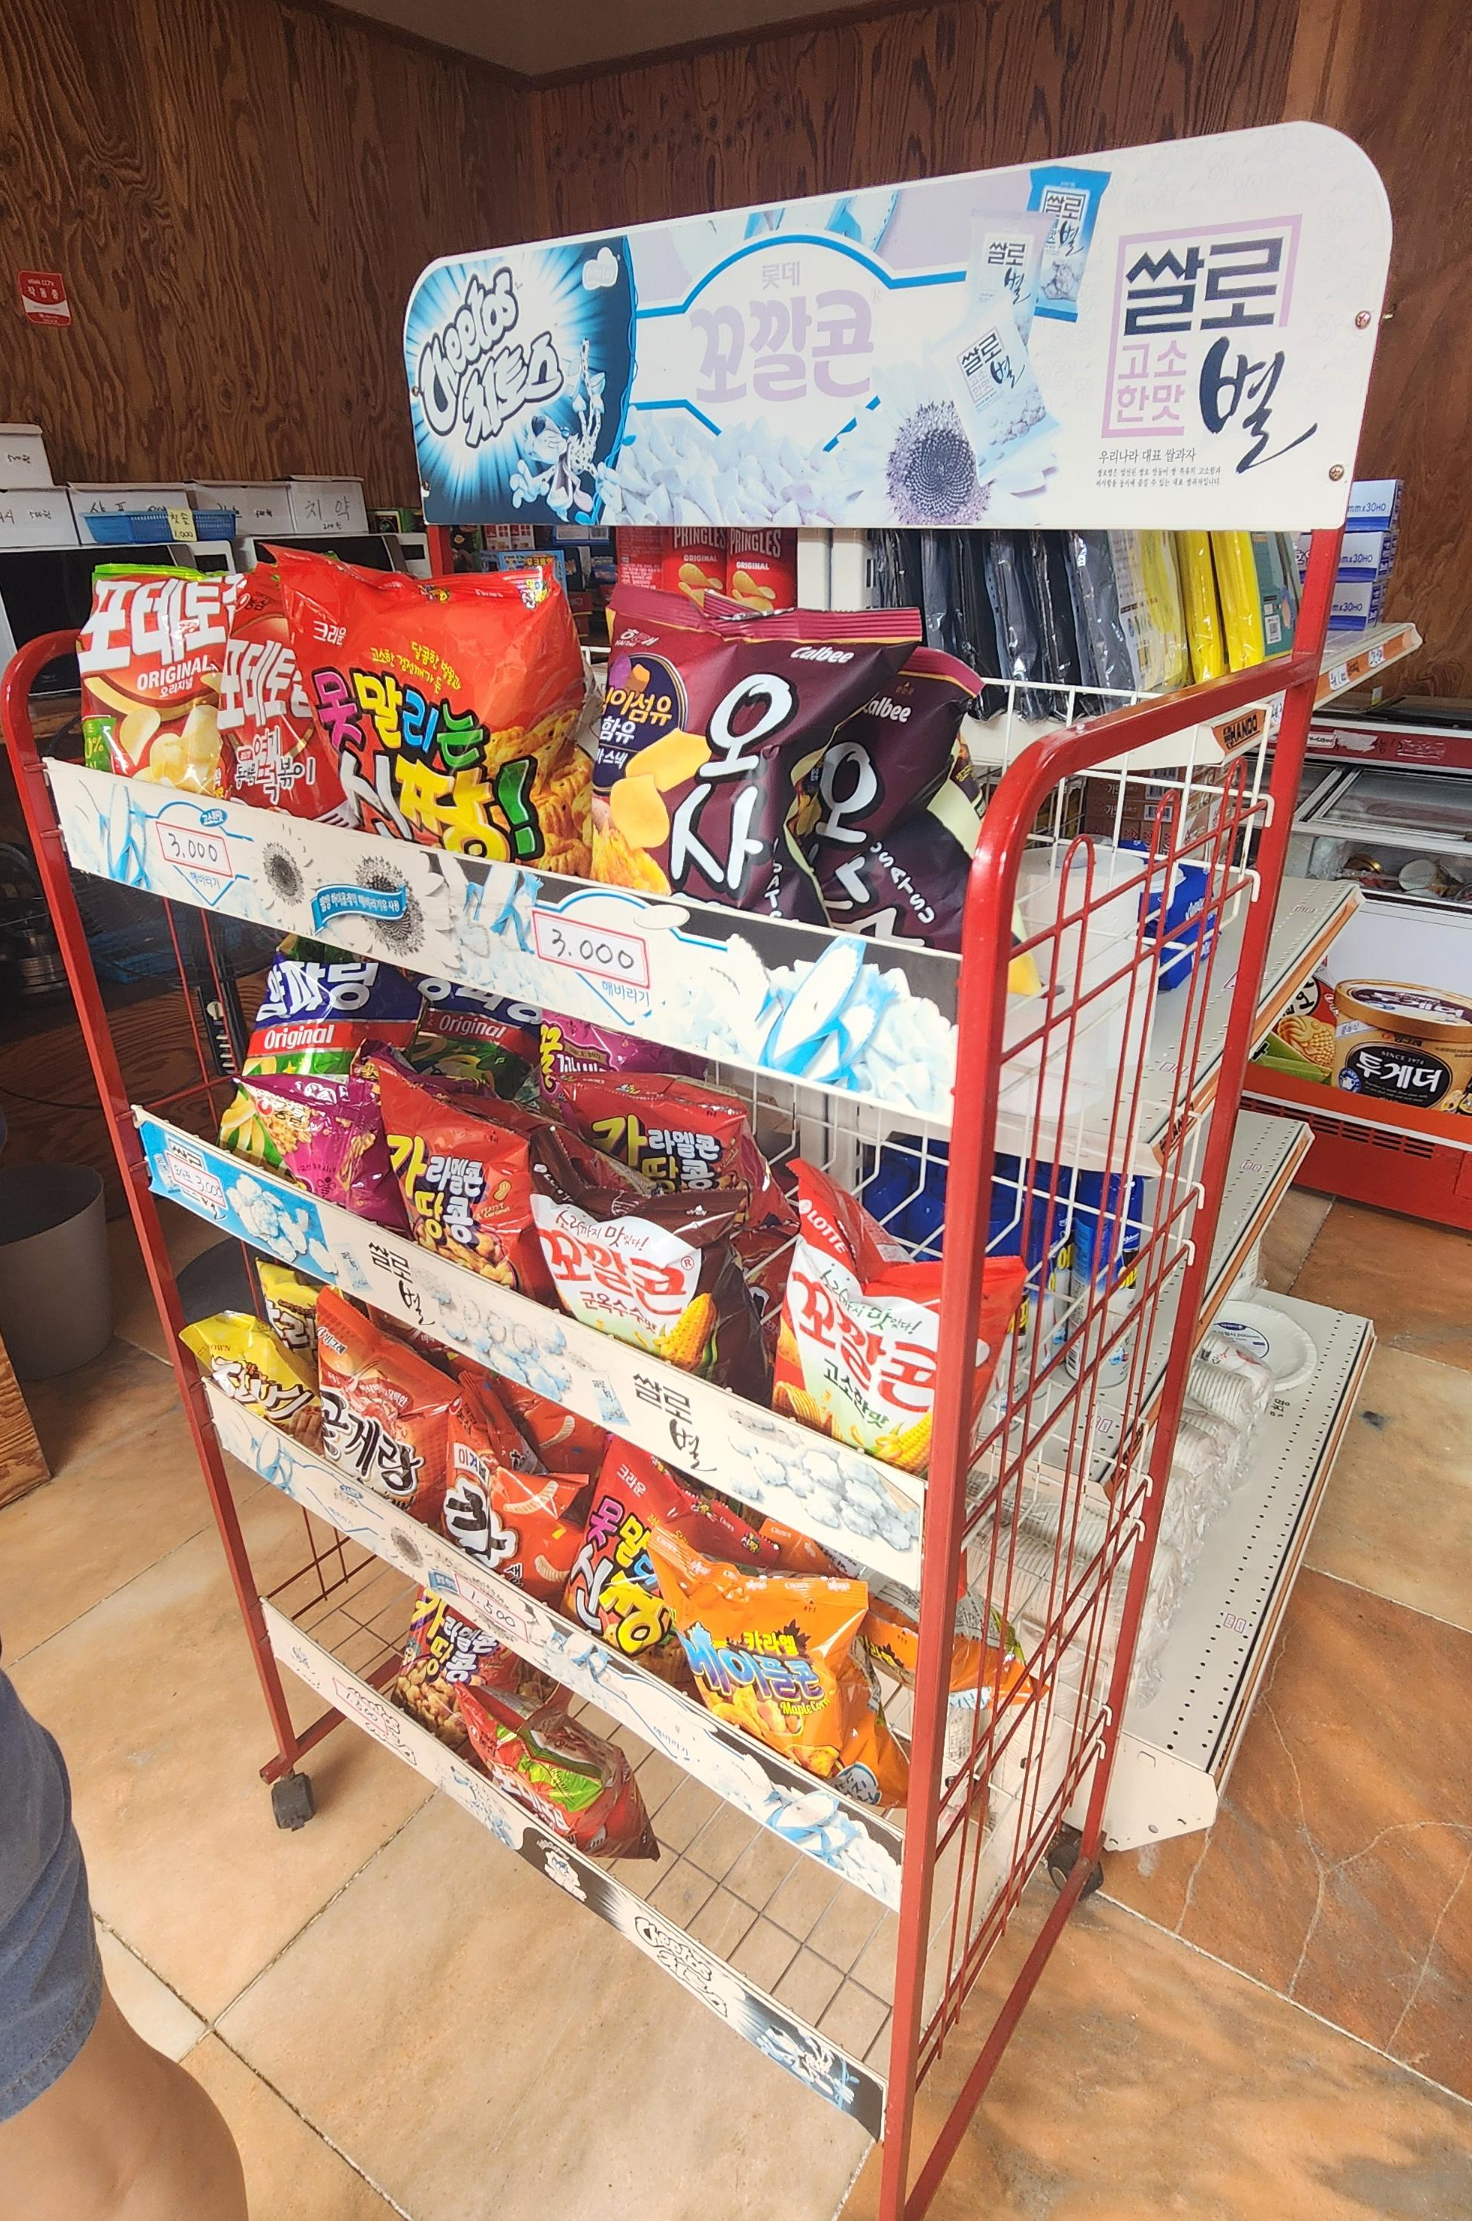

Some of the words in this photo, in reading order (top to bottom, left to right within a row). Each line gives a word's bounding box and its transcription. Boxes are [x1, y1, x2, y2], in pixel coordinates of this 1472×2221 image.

[988, 242, 1026, 267] 쌀로
[762, 261, 800, 291] 롯데
[1004, 267, 1031, 305] 별
[1123, 236, 1284, 336] 쌀로
[419, 267, 518, 436] Cheetos
[689, 289, 875, 403] 꼬깔콘
[961, 332, 1003, 377] 쌀로
[1117, 340, 1187, 380] 고소
[463, 331, 564, 449] 치토스
[1116, 386, 1186, 424] 한맛
[1199, 336, 1319, 475] 별
[1099, 449, 1139, 464] 우리나라
[1142, 448, 1162, 463] 대표
[1165, 447, 1197, 463] 쌀과자
[730, 528, 782, 558] PRINGLES
[684, 555, 718, 563] ORIGINAL
[736, 561, 769, 571] ORIGINAL
[77, 575, 245, 673] 포테토
[313, 620, 347, 646] 크라운
[137, 655, 212, 691] ORIGINAL
[791, 646, 855, 664] Calbee
[159, 677, 193, 698] 오리지널
[313, 671, 484, 768] 못말리는
[599, 715, 636, 744] 함유
[602, 980, 650, 1007] 해바라기
[263, 1024, 335, 1050] Original
[438, 1014, 508, 1041] Original
[1356, 1051, 1443, 1093] 투게더
[1381, 1050, 1406, 1062] SINCE
[415, 1190, 474, 1244] 땅콩
[808, 1209, 848, 1255] LOTTE
[604, 1226, 650, 1251] 맛있다!
[368, 1241, 414, 1285] 쌀로
[537, 1227, 687, 1316] 꼬깔콘
[867, 1306, 922, 1335] 맛있다!
[792, 1271, 938, 1413] 꼬깔콘
[633, 1372, 693, 1426] 쌀로
[823, 1357, 890, 1430] 고소한맛
[616, 1463, 648, 1499] 크라운
[744, 1630, 799, 1656] 카라멜
[634, 1916, 713, 1982] Cheetos
